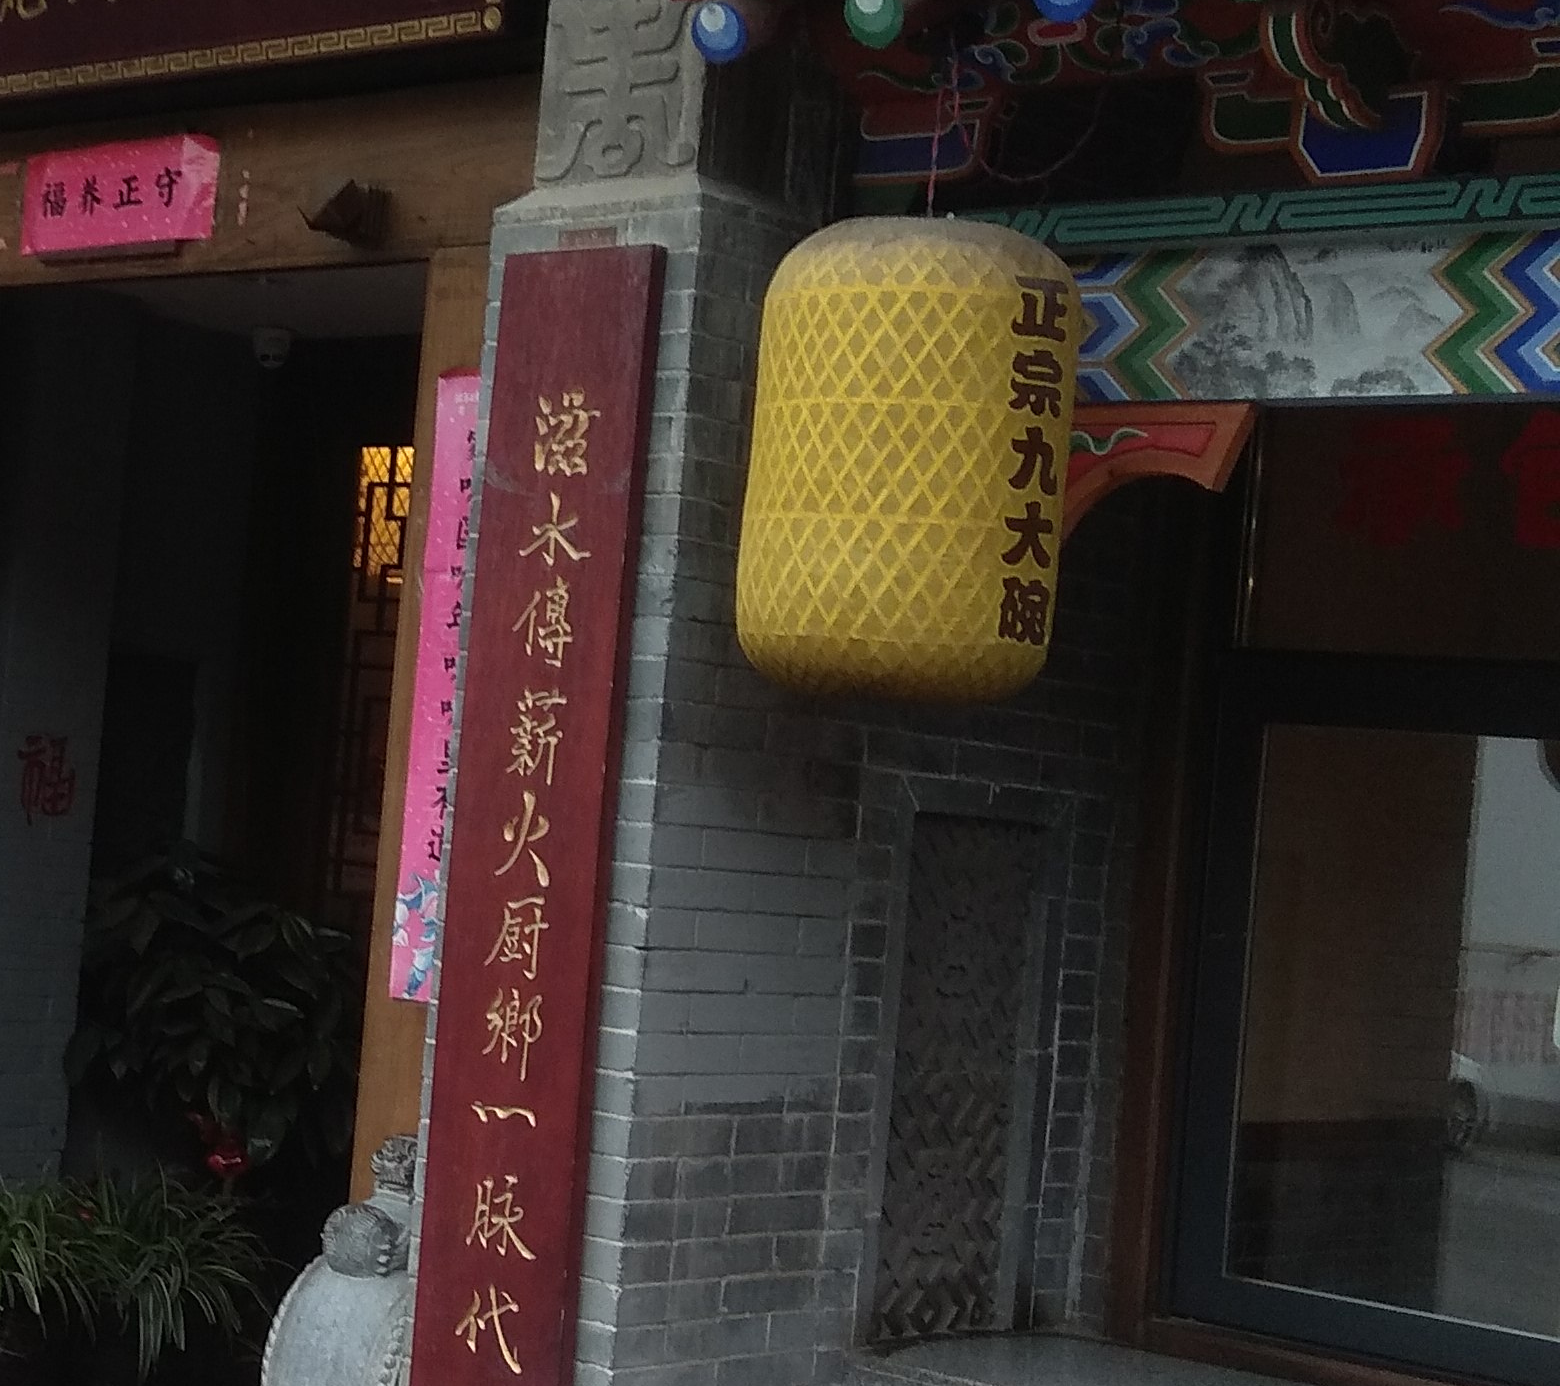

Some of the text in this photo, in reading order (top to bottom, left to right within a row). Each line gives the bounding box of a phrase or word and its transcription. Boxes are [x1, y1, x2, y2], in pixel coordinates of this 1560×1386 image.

[997, 274, 1071, 648] 正宗九大碗
[17, 734, 76, 825] 福
